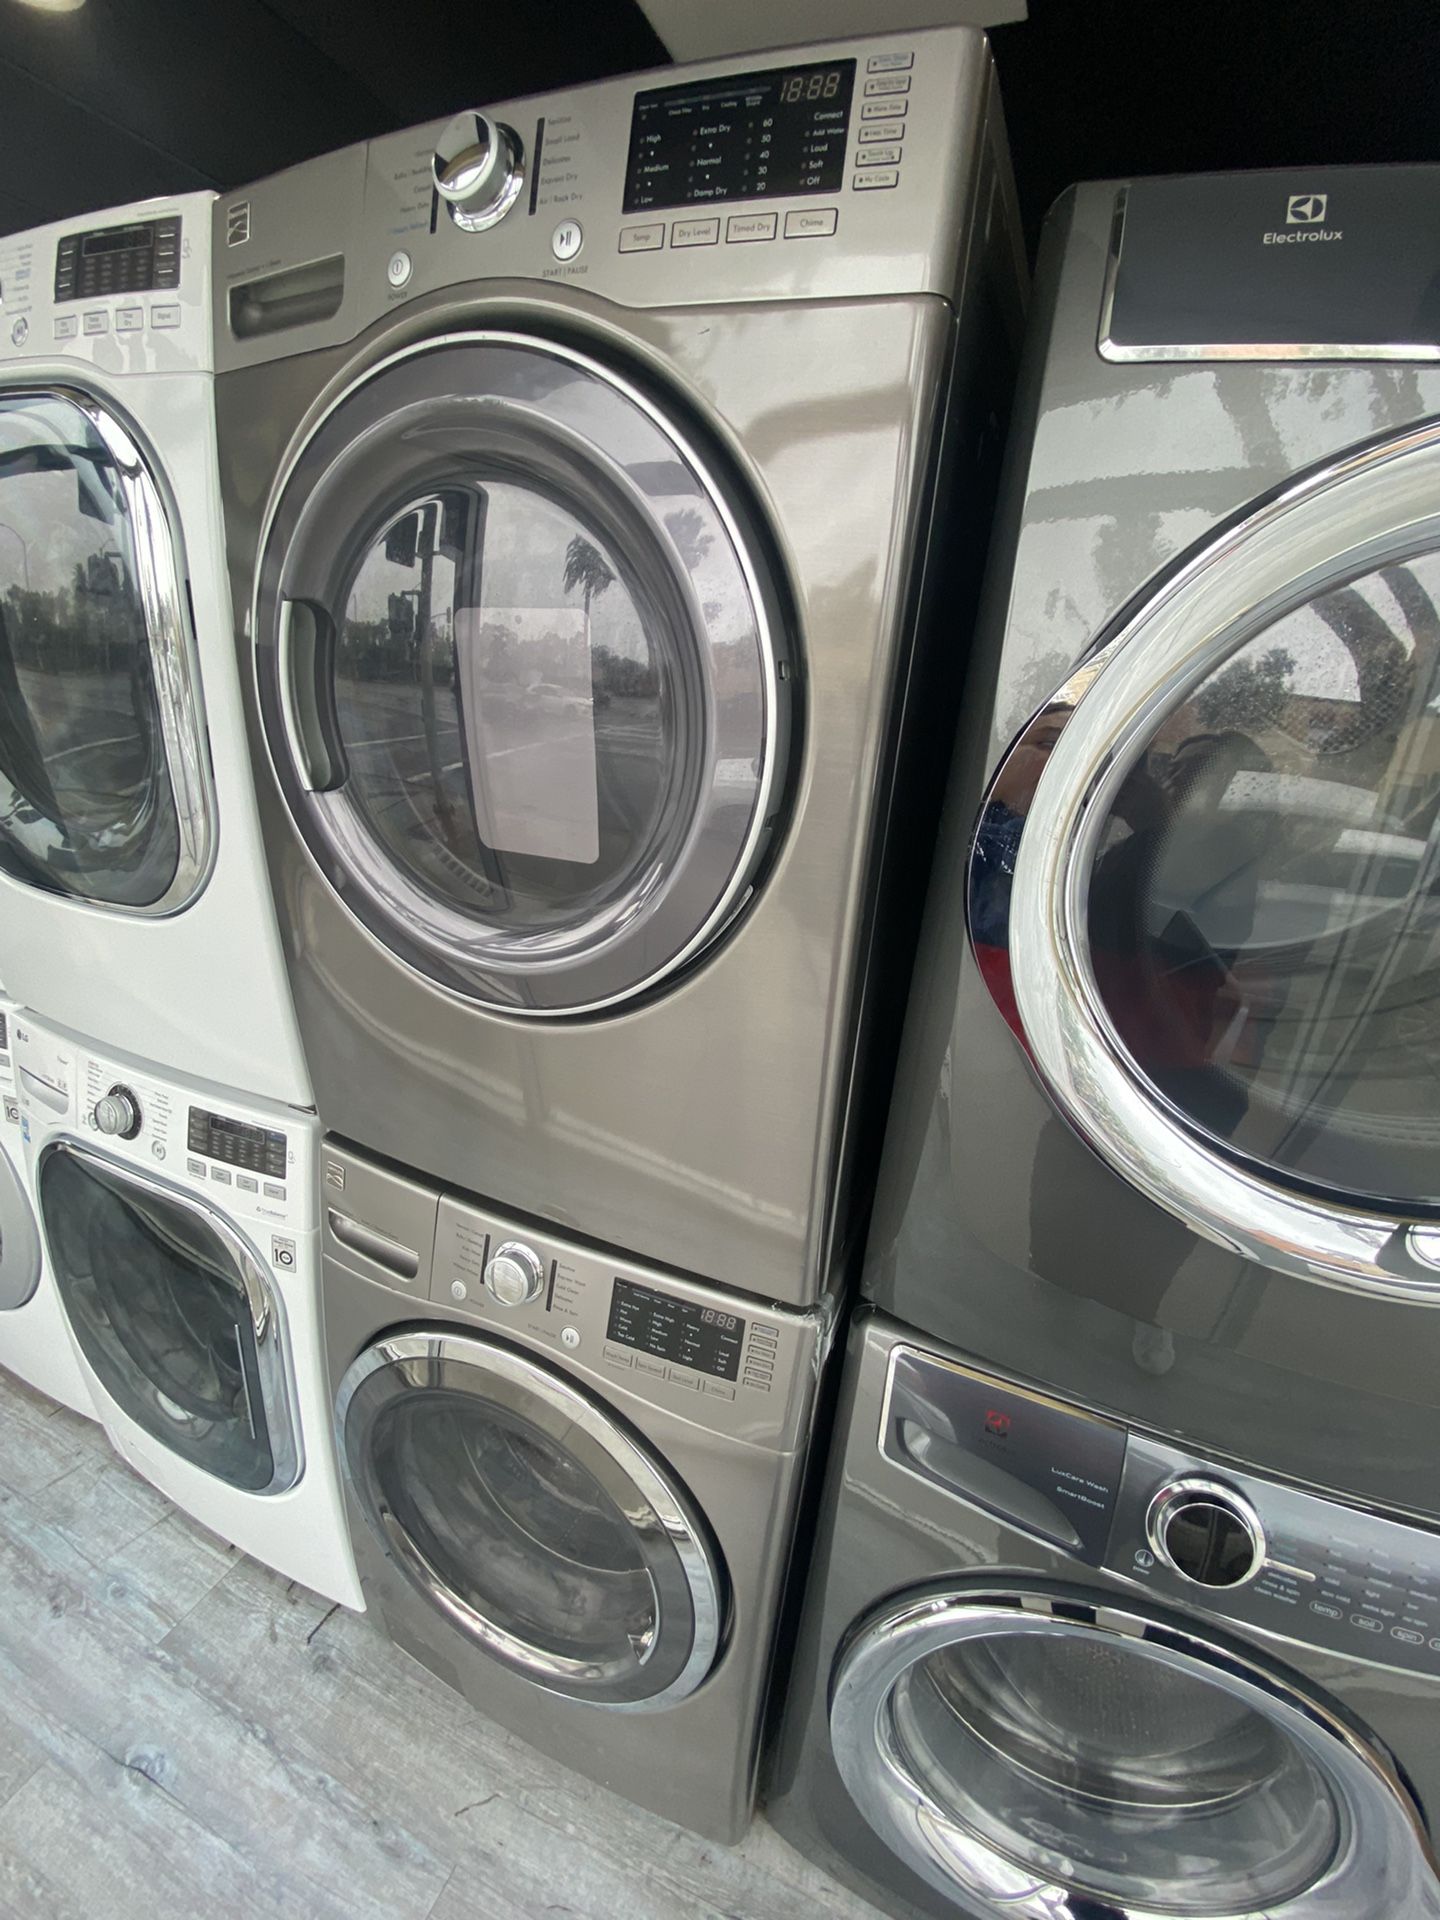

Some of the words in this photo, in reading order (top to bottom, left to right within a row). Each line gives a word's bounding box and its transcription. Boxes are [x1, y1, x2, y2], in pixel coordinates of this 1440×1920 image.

[814, 111, 843, 120] Connect
[763, 118, 773, 127] 60
[700, 126, 717, 135] Extra
[719, 124, 731, 133] Dry
[646, 134, 661, 143] High
[761, 134, 771, 143] 50
[810, 144, 828, 152] Loud
[760, 150, 769, 158] 40
[697, 157, 721, 166] Normal
[809, 160, 823, 169] Soft
[644, 164, 669, 173] Medium
[758, 166, 767, 174] 30
[807, 176, 820, 185] Off
[757, 182, 766, 191] 20
[694, 190, 713, 198] Damp
[716, 186, 727, 195] Dry
[800, 218, 823, 228] Chime
[679, 228, 691, 238] Dry
[693, 227, 711, 236] Level
[733, 224, 756, 233] Timed
[757, 223, 770, 232] Dry
[1263, 229, 1343, 244] Electrolux
[274, 1248, 293, 1265] 10
[1051, 1467, 1084, 1483] LuxCare
[1086, 1480, 1108, 1493] Wash
[1057, 1486, 1104, 1509] SmartBoost
[1314, 1604, 1338, 1617] temp
[1358, 1618, 1375, 1628] soil
[1398, 1630, 1417, 1642] spin
